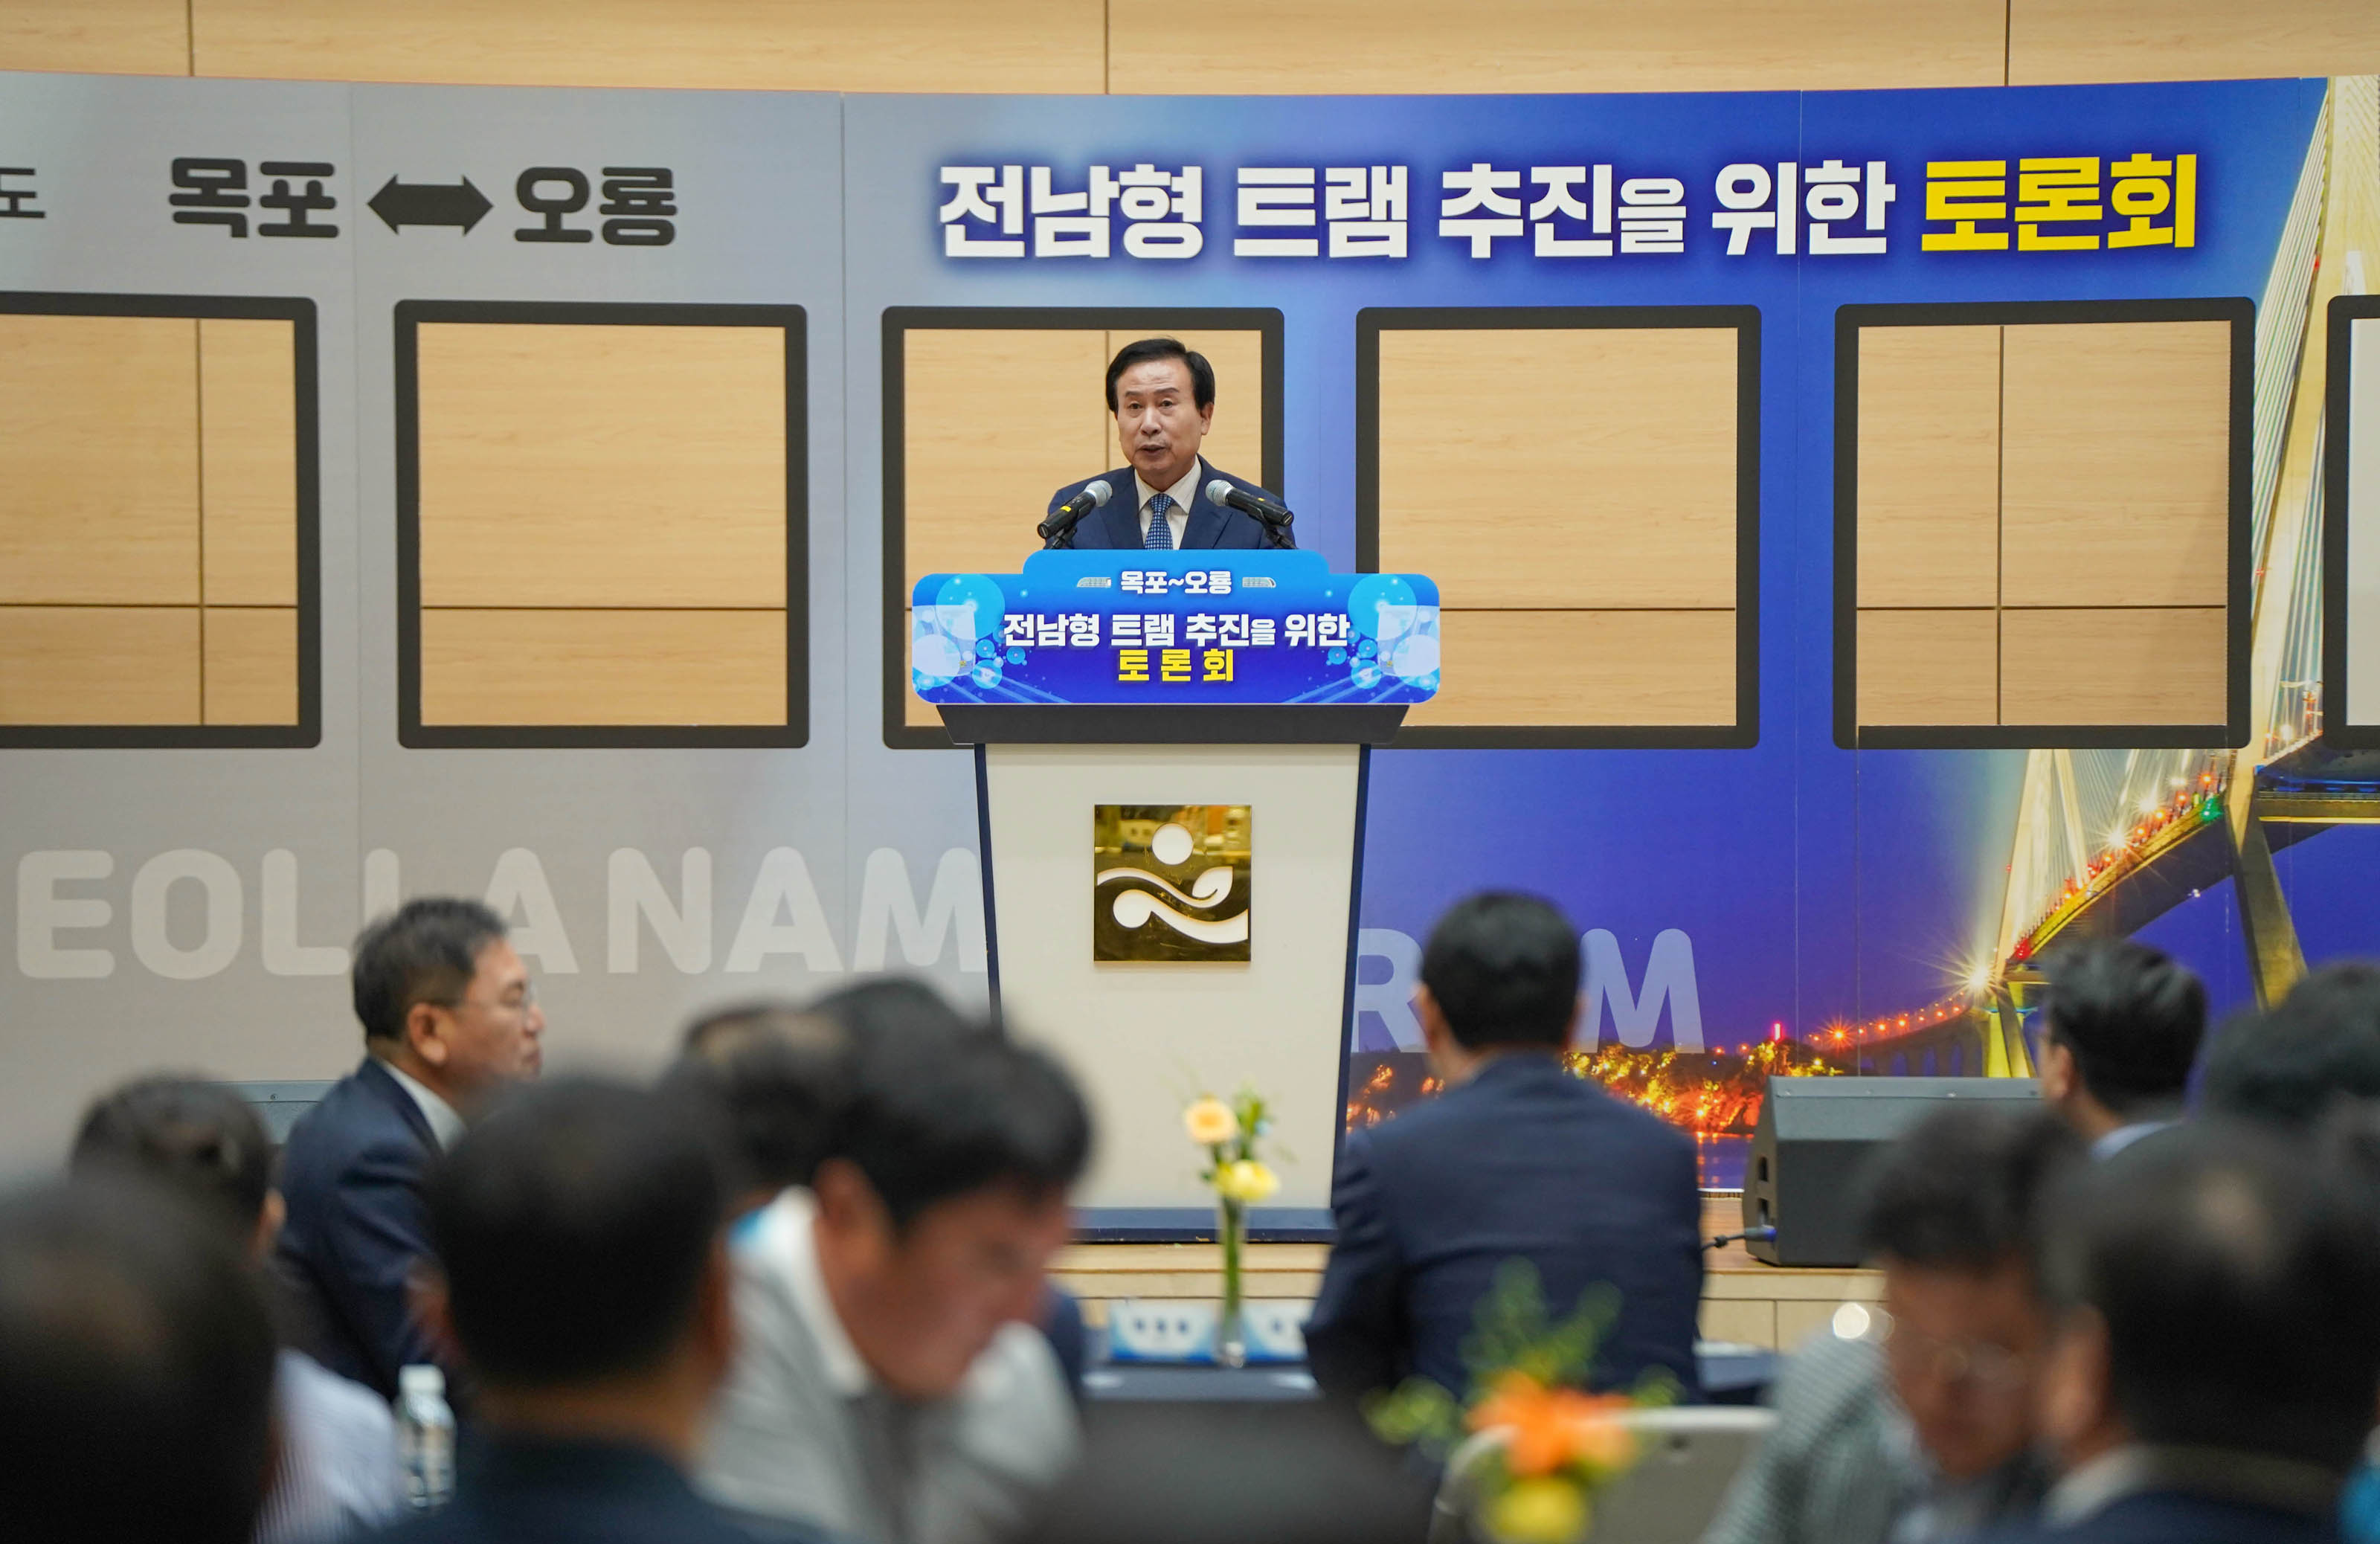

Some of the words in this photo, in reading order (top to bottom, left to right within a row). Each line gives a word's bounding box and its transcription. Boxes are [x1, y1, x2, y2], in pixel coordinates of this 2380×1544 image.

[168, 156, 340, 239] 목포
[514, 166, 678, 246] 오룡
[939, 163, 1203, 259] 전남형
[1233, 164, 1409, 259] 트램
[1438, 161, 1687, 259] 추진을
[1711, 159, 1896, 255] 위한
[1921, 152, 2197, 252] 토론회
[1121, 570, 1232, 594] 목포~오룡
[1003, 613, 1100, 646] 전남형
[1111, 613, 1175, 646] 트램
[1186, 613, 1276, 646] 추진을
[1284, 613, 1350, 646] 위한
